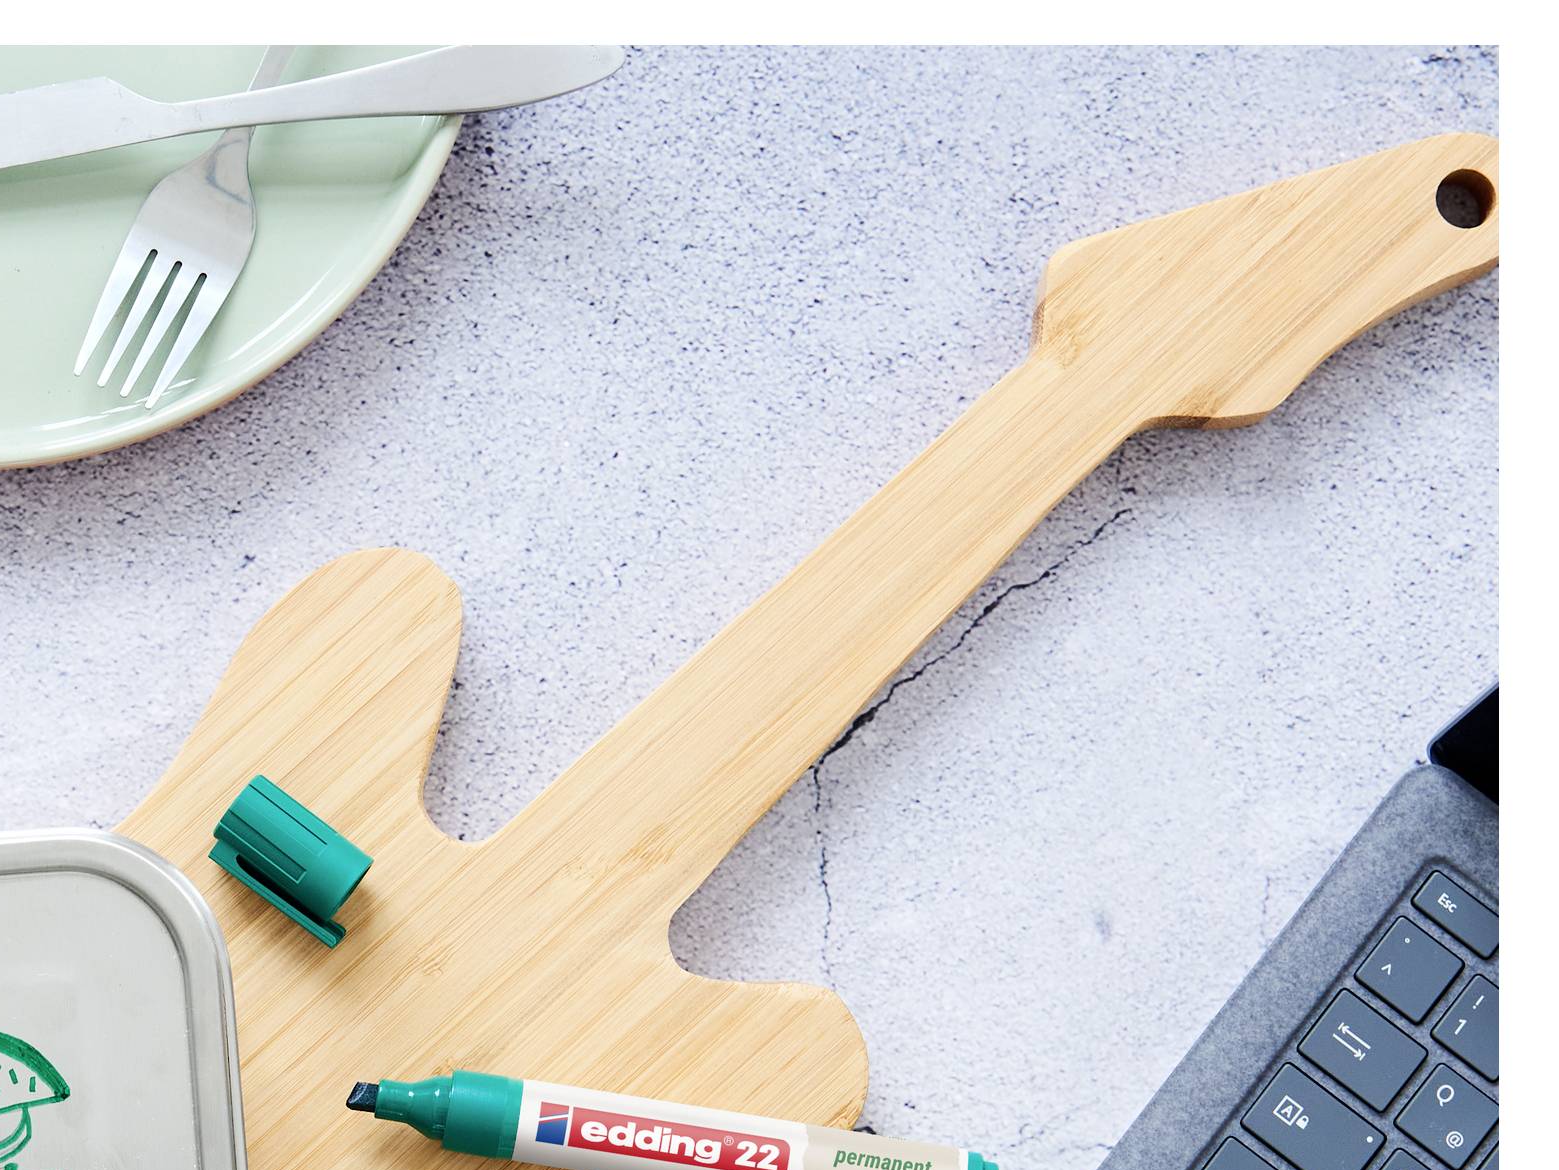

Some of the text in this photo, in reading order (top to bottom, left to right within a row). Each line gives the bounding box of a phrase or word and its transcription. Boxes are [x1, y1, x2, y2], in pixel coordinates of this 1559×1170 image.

[1437, 892, 1457, 913] Esc
[1454, 1019, 1467, 1035] 1
[1436, 1084, 1455, 1107] Q
[1445, 1131, 1464, 1149] @
